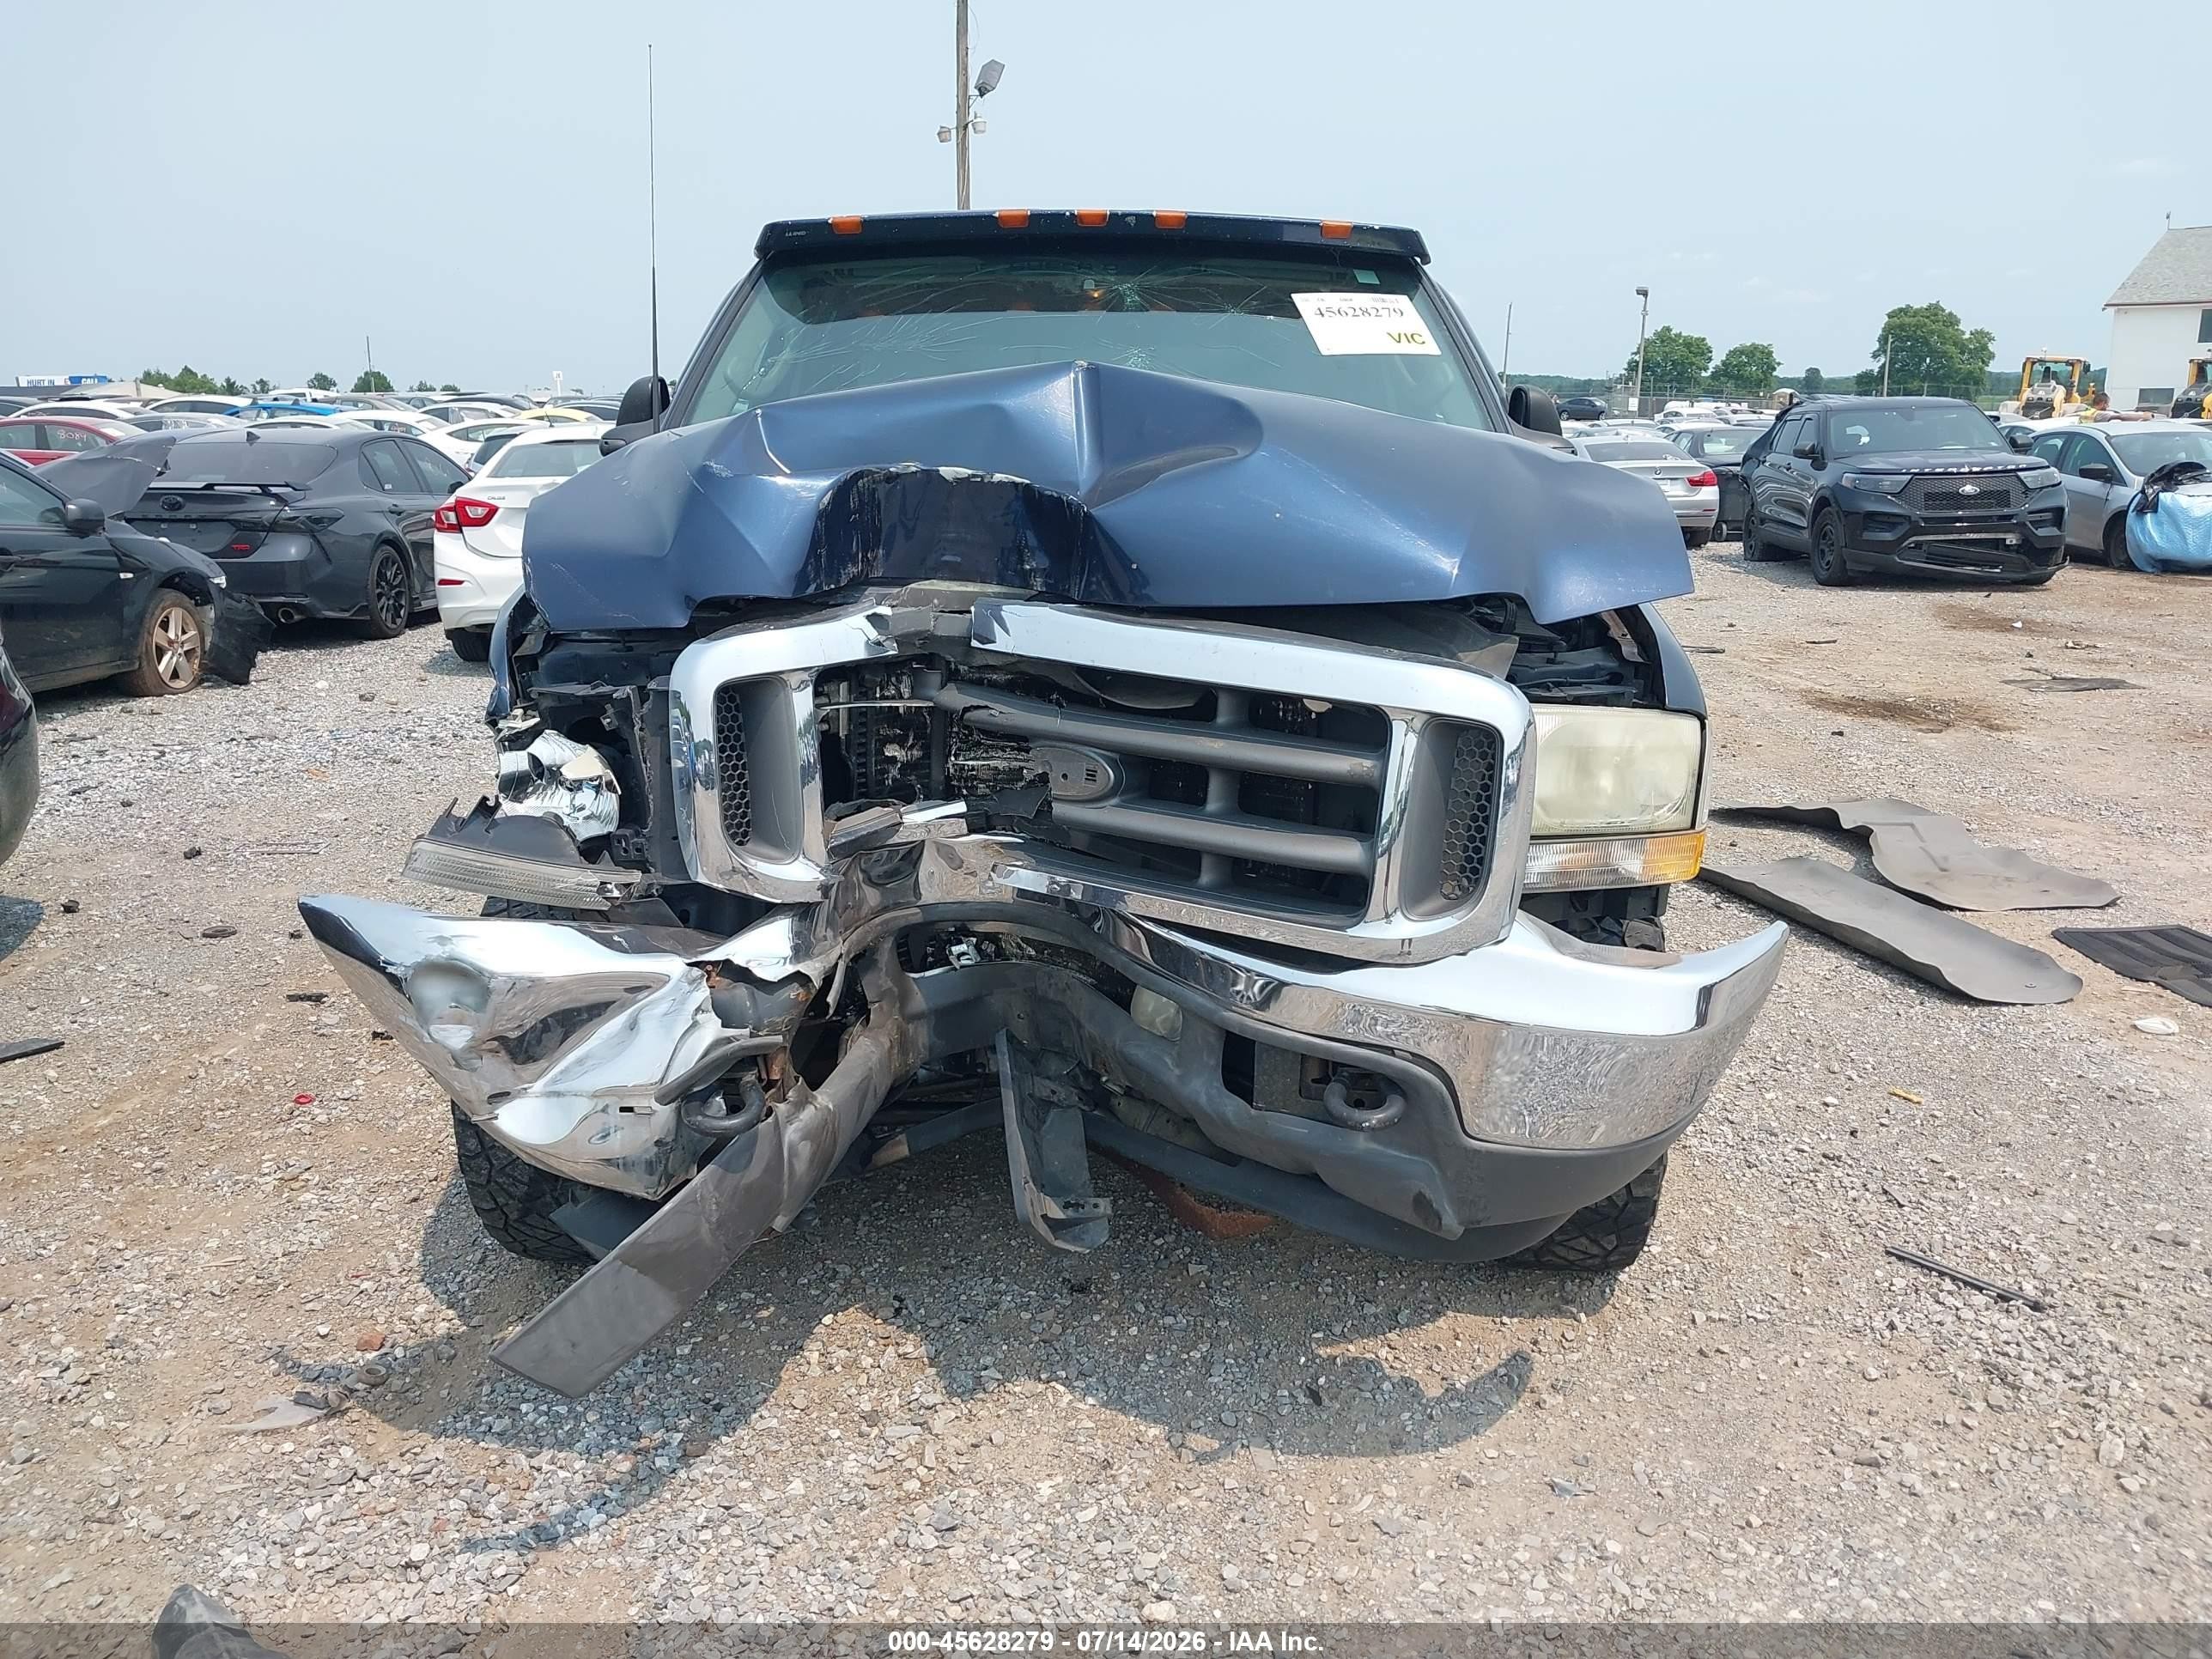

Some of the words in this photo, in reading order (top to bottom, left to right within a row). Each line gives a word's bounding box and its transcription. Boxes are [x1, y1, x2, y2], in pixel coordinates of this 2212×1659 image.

[1315, 307, 1404, 318] 45628279
[1386, 331, 1426, 344] VIC
[27, 378, 46, 386] HURT
[47, 378, 55, 386] IN
